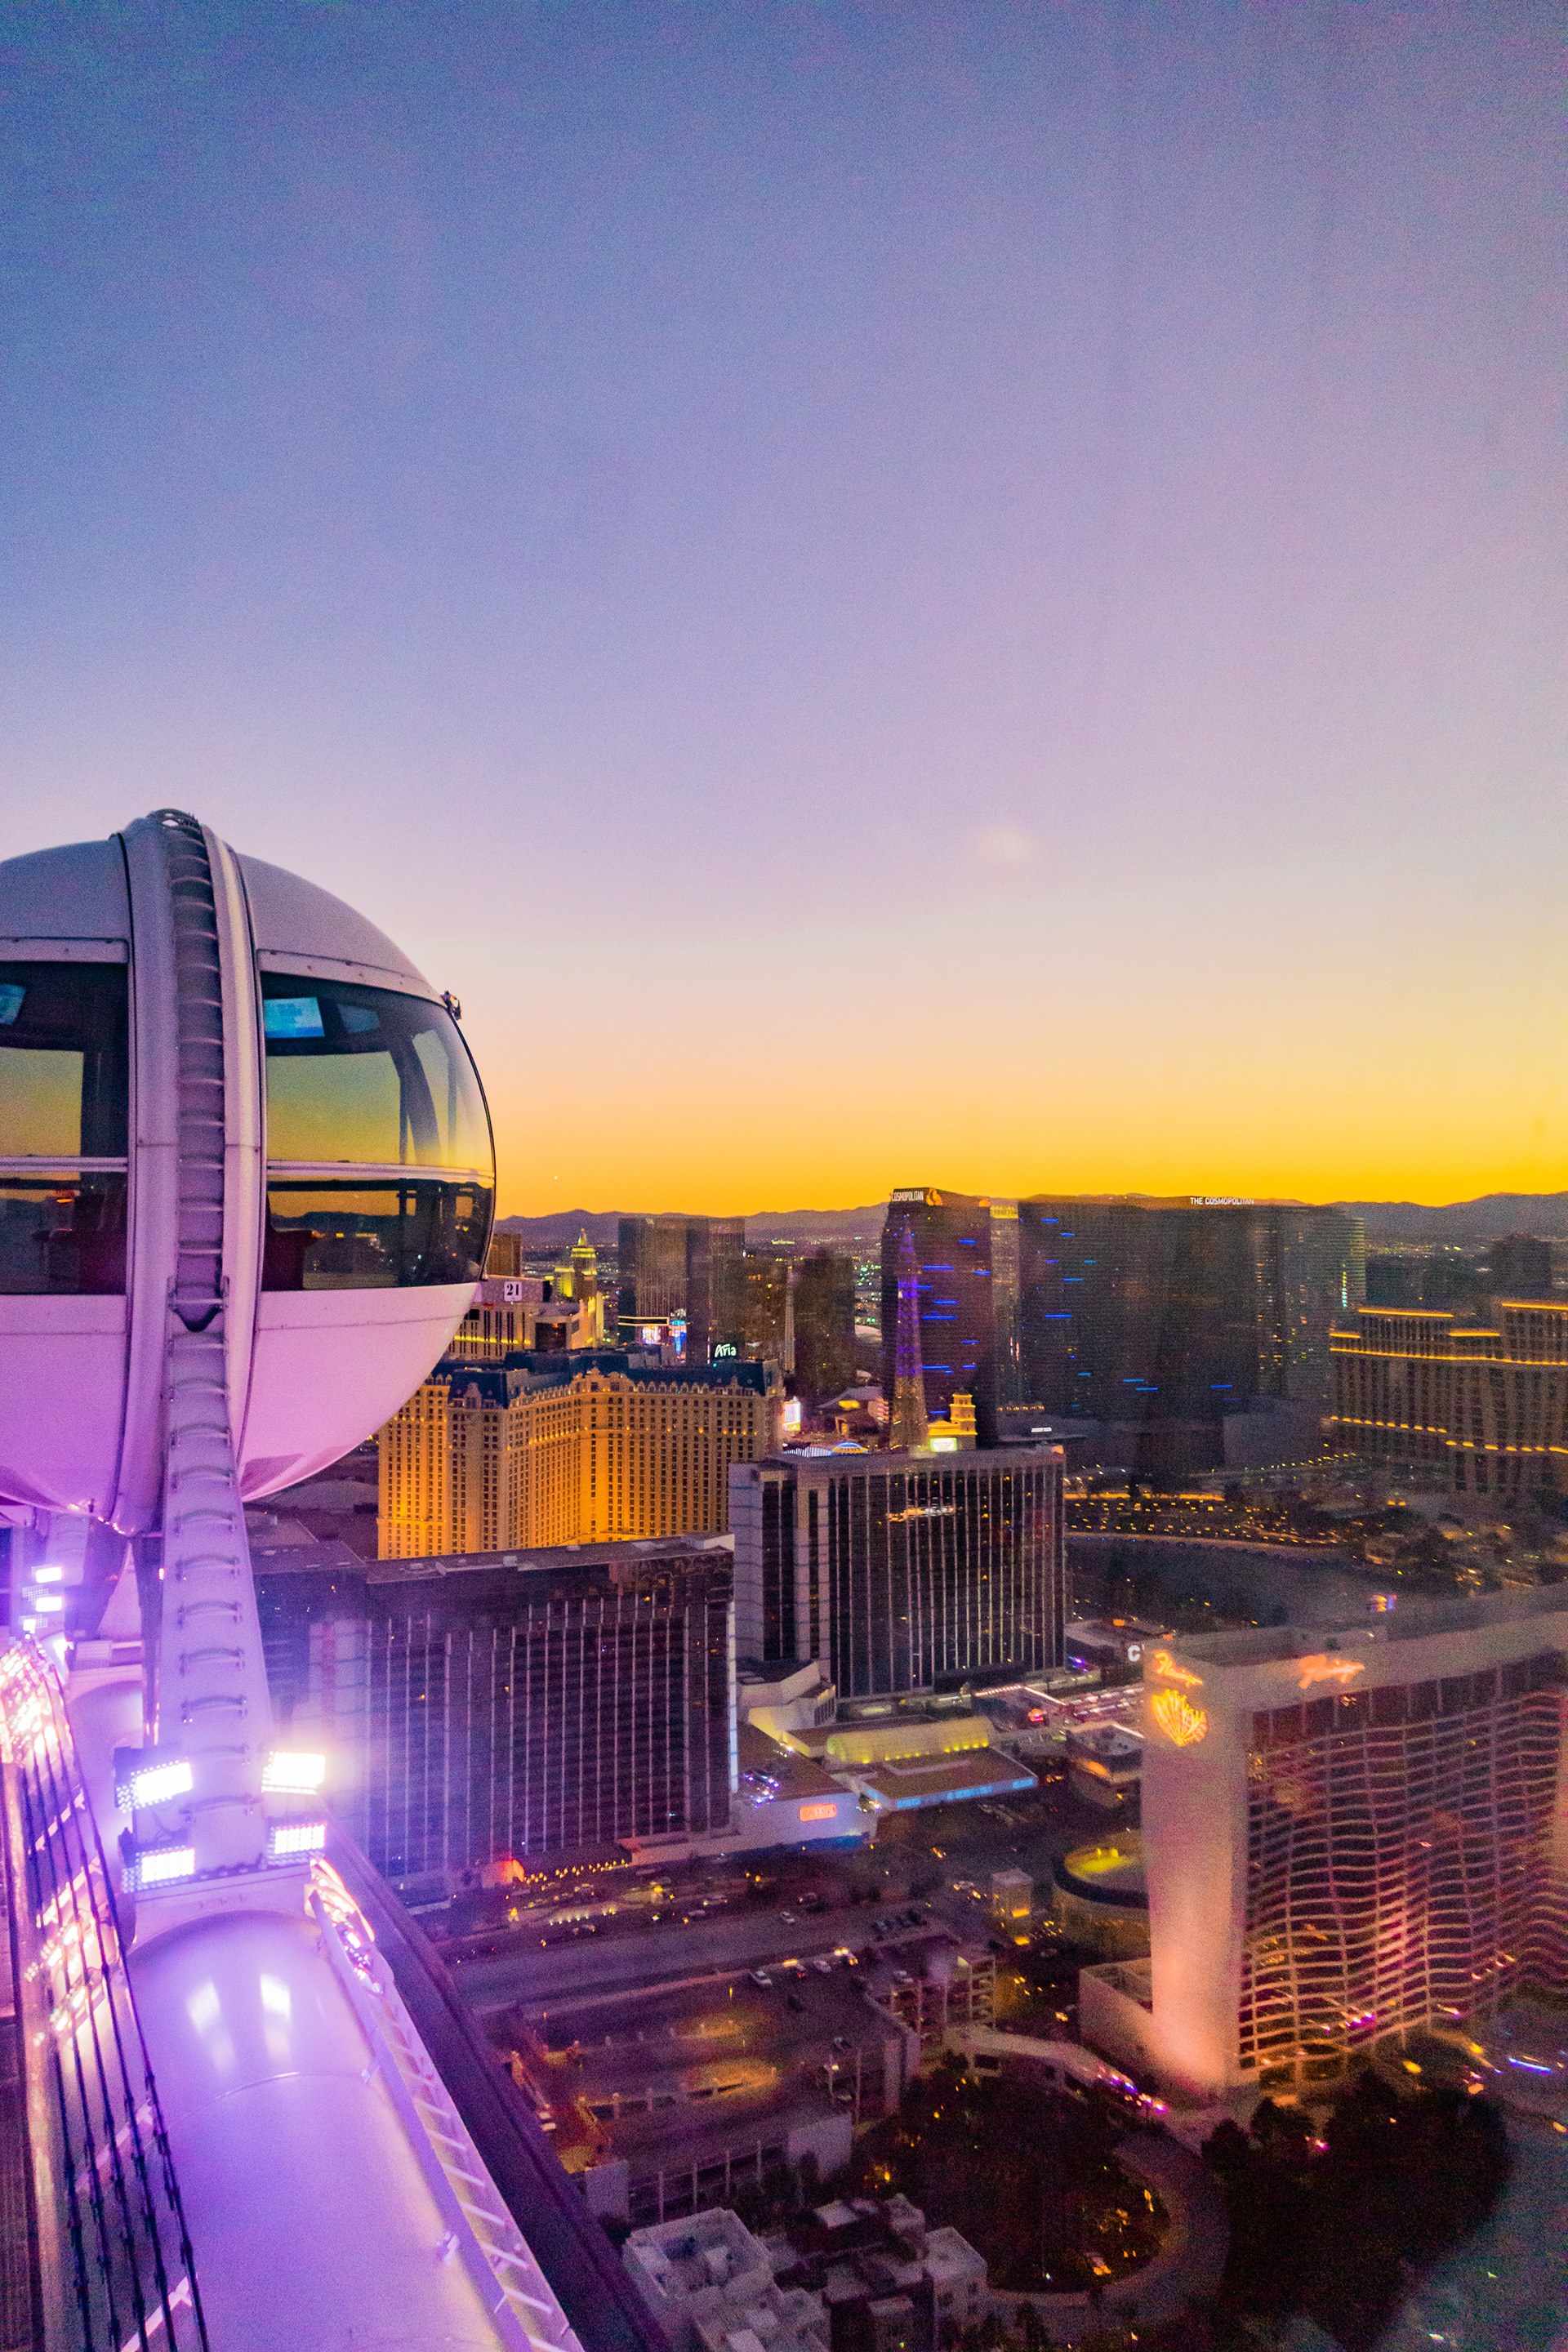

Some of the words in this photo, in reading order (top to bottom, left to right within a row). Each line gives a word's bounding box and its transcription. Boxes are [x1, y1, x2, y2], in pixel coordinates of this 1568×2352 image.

[1205, 1197, 1254, 1205] COSMOPOLITAN
[506, 1284, 519, 1295] 21
[715, 1343, 737, 1357] Aria
